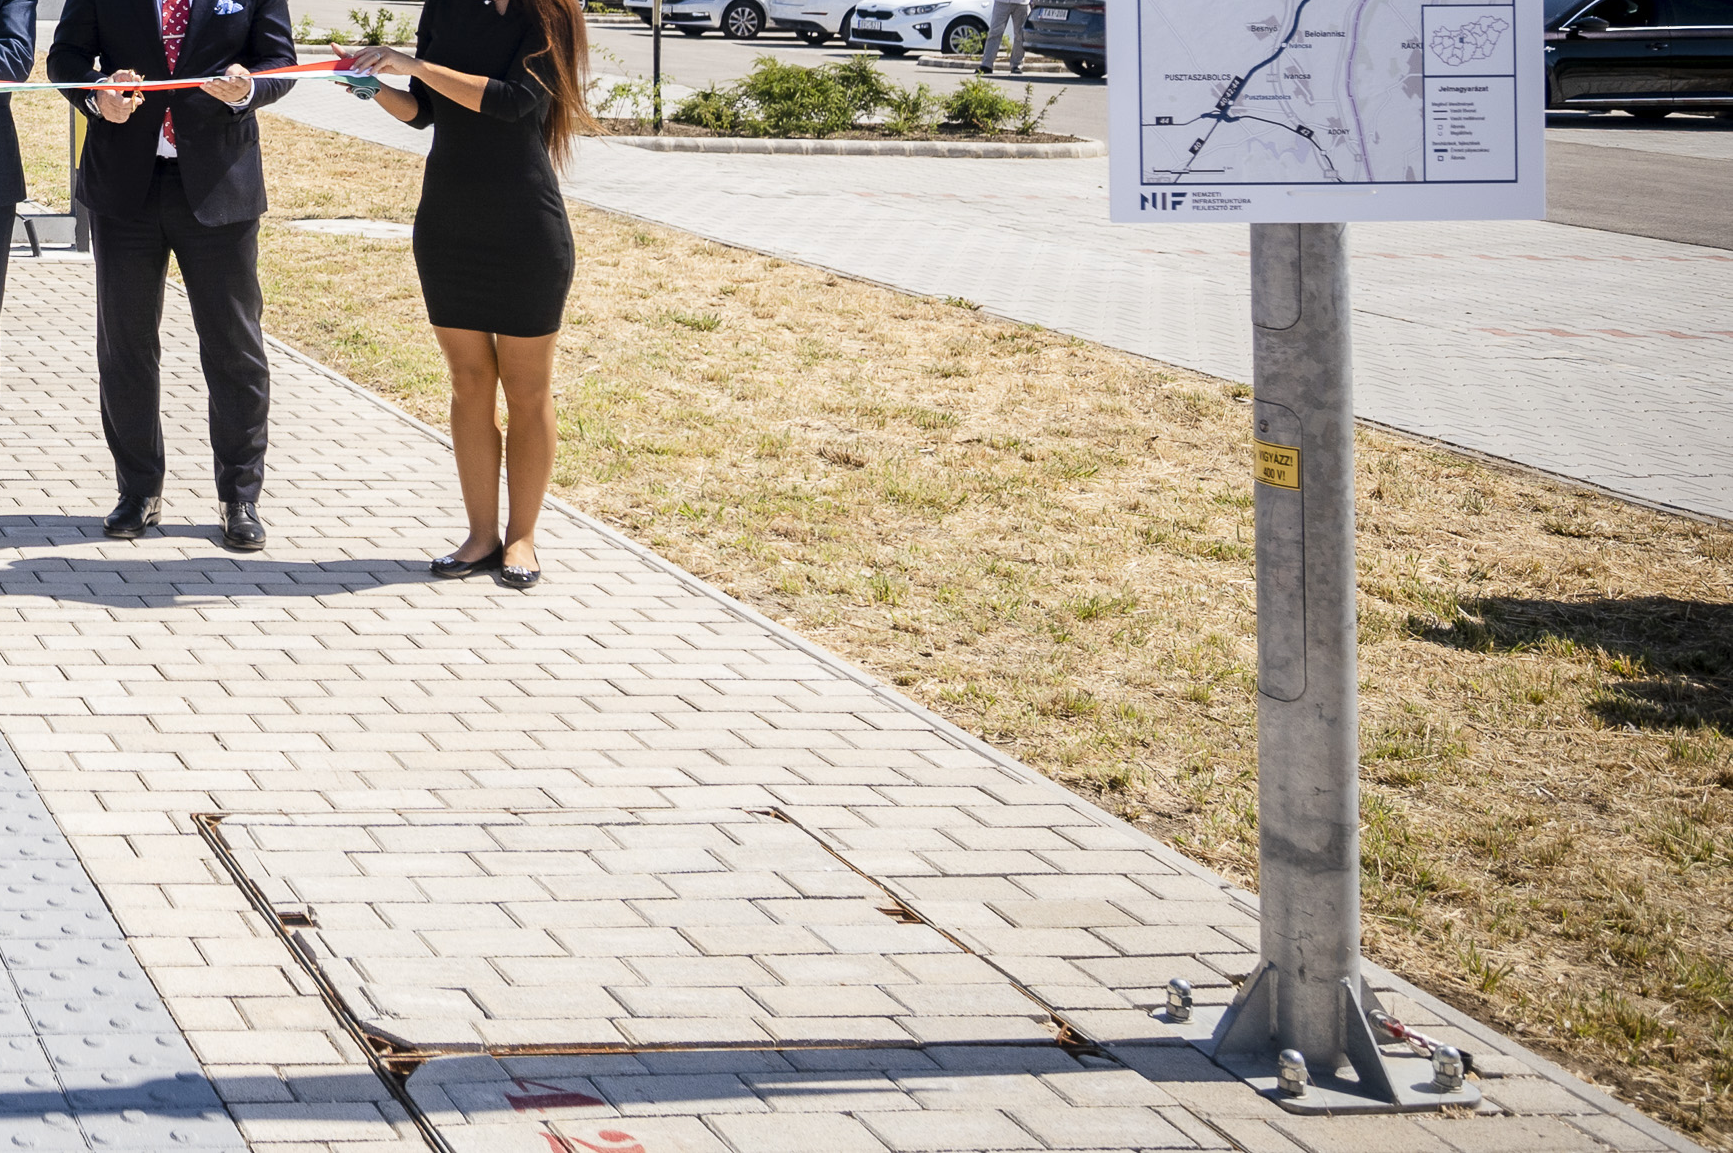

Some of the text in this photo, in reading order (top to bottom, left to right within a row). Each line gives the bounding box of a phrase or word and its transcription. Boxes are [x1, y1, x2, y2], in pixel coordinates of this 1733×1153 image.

[1304, 30, 1346, 38] Beloiannisz
[1244, 93, 1292, 101] Pusztaszabolcs
[1299, 127, 1311, 137] 42
[1193, 141, 1202, 152] 40
[1140, 192, 1188, 211] NIF
[1259, 450, 1293, 467] VIGYÁZZ!
[1263, 466, 1286, 481] 400 V!
